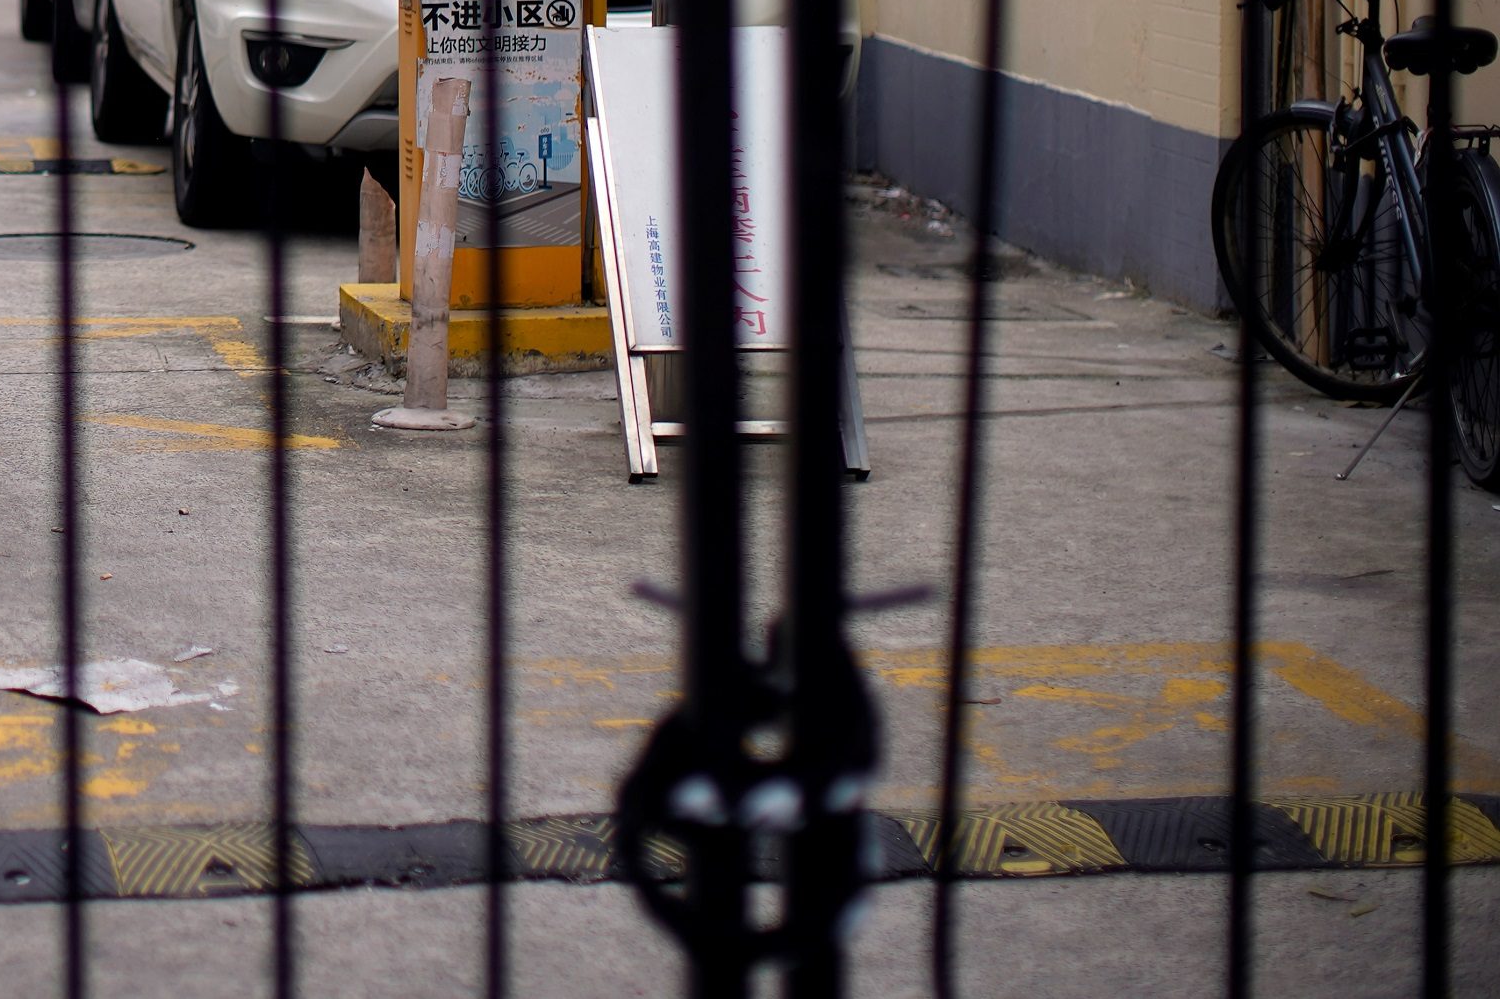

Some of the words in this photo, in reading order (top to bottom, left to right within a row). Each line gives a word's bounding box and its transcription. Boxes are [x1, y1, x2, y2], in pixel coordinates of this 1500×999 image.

[422, 0, 545, 32] 不进小区
[645, 215, 673, 339] 上海高建物业有限公司
